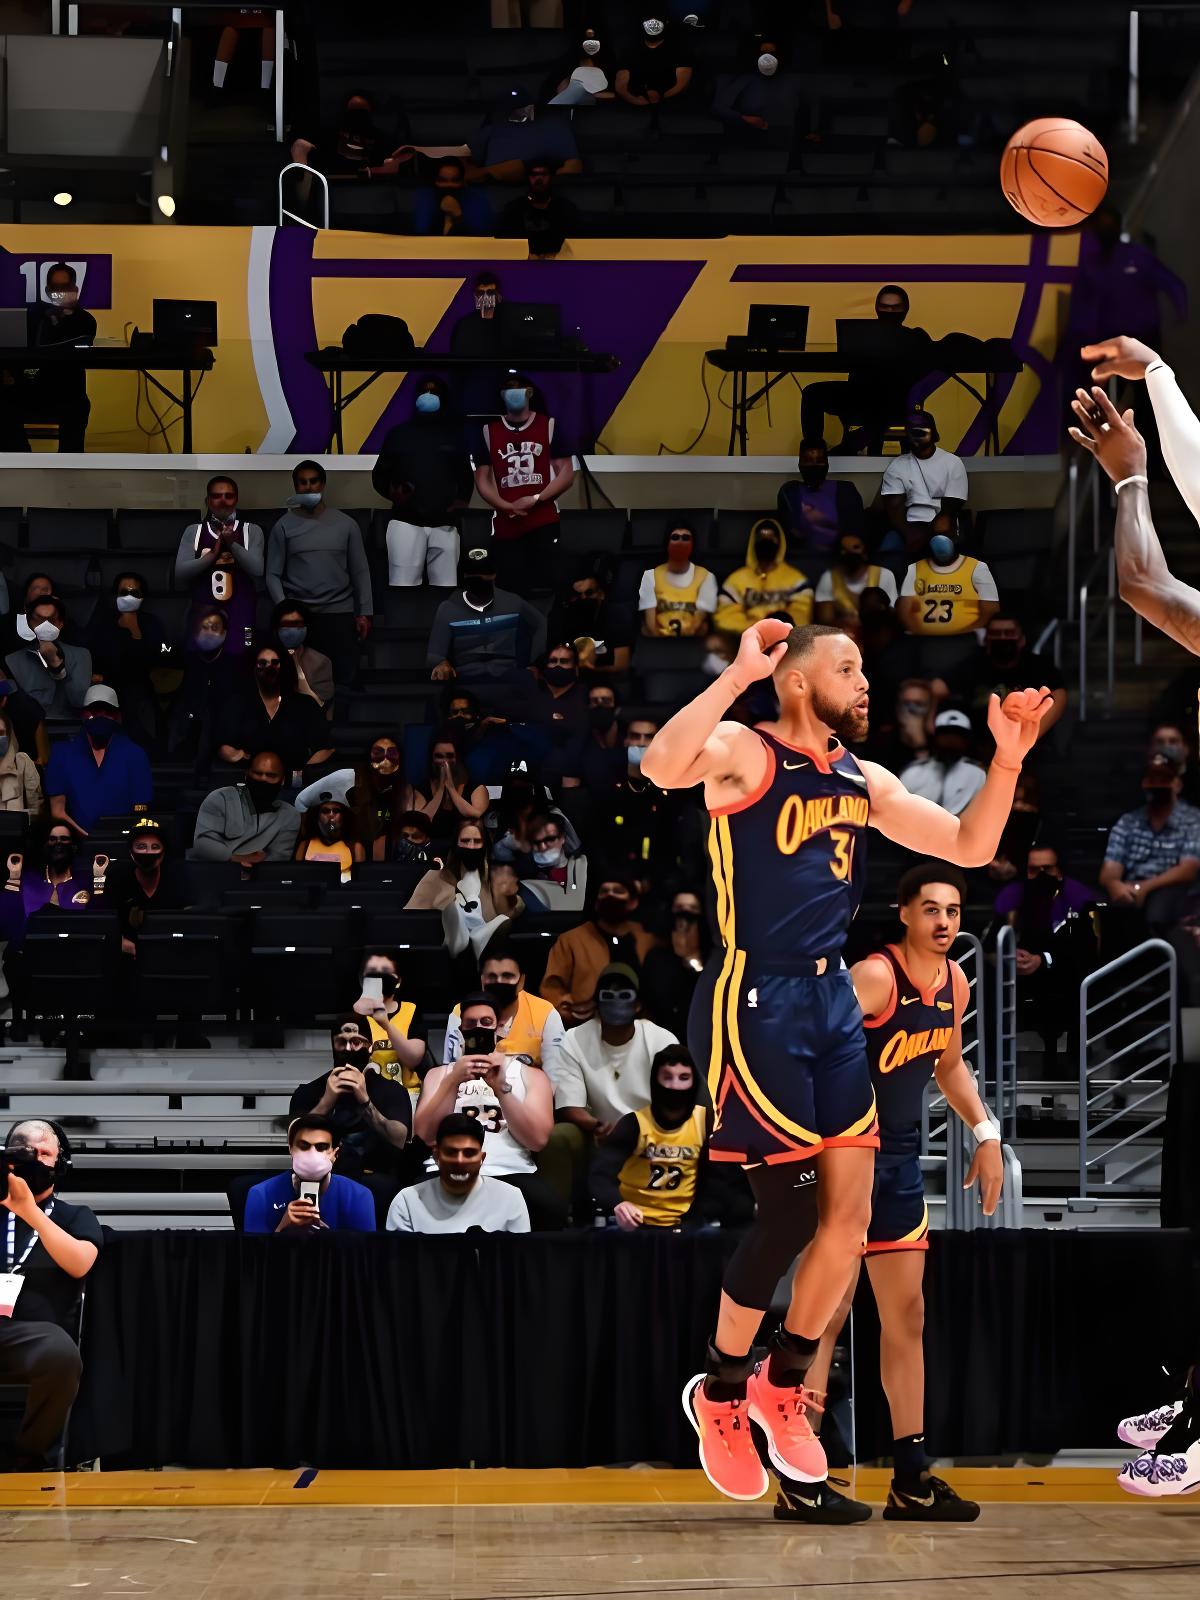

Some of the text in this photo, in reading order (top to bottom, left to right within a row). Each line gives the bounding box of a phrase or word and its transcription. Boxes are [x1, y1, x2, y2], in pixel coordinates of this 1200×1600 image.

[923, 599, 954, 623] 23
[776, 794, 869, 856] OAKLAND
[829, 827, 856, 885] 3
[879, 1027, 954, 1074] OAKLAN
